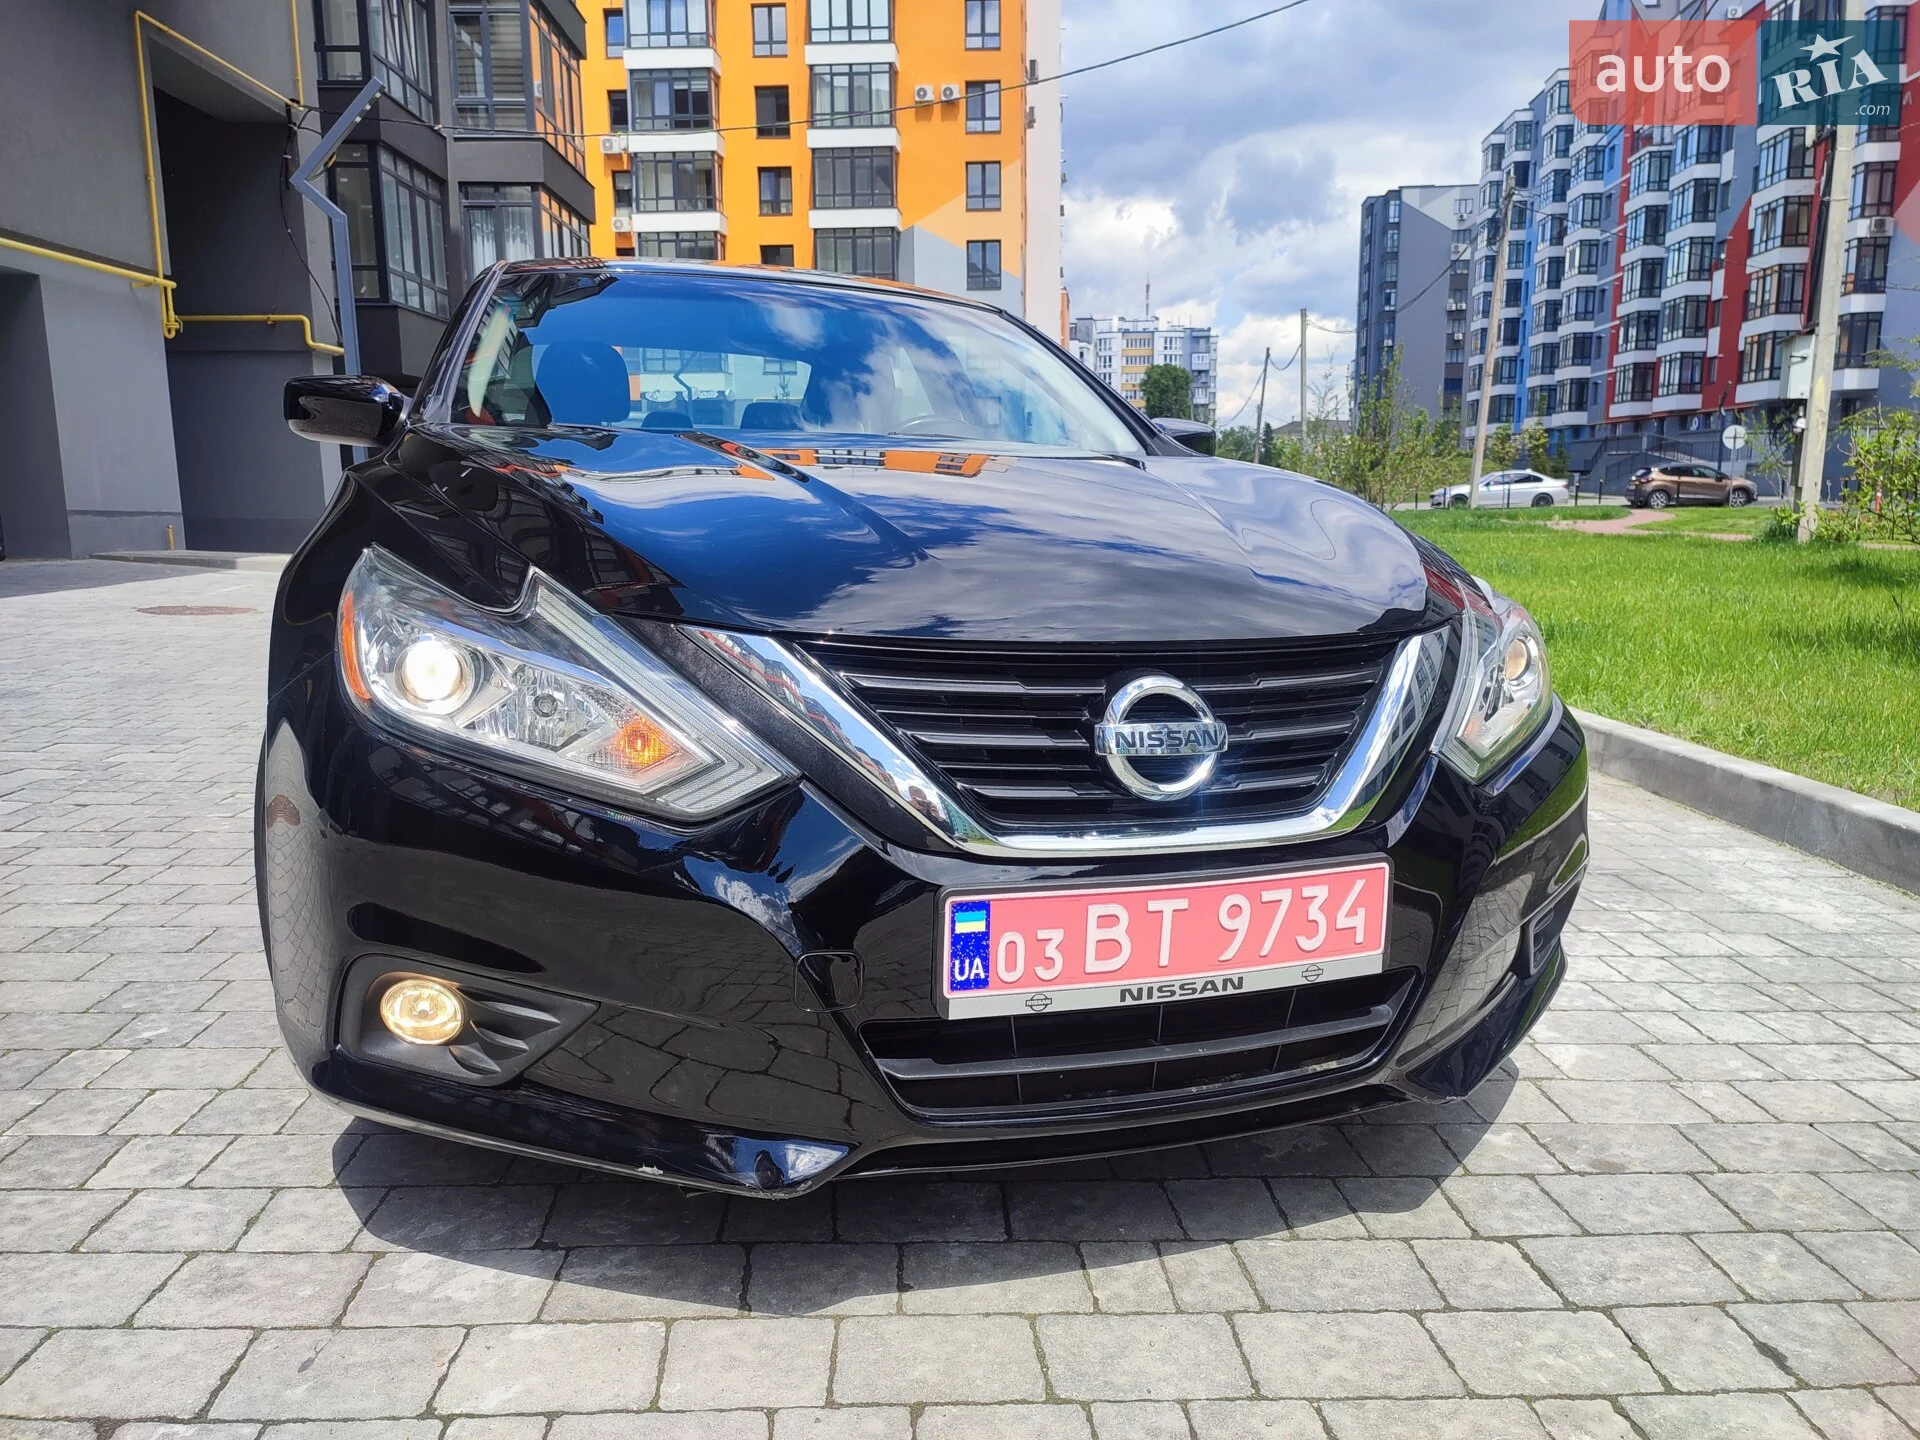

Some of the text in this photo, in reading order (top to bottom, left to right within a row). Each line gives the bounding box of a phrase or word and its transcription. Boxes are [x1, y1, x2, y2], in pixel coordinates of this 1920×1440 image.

[1114, 729, 1219, 749] NISSAN
[996, 878, 1367, 984] 03 BT 9734
[954, 957, 986, 981] UA
[1119, 976, 1245, 1003] NISSAN
